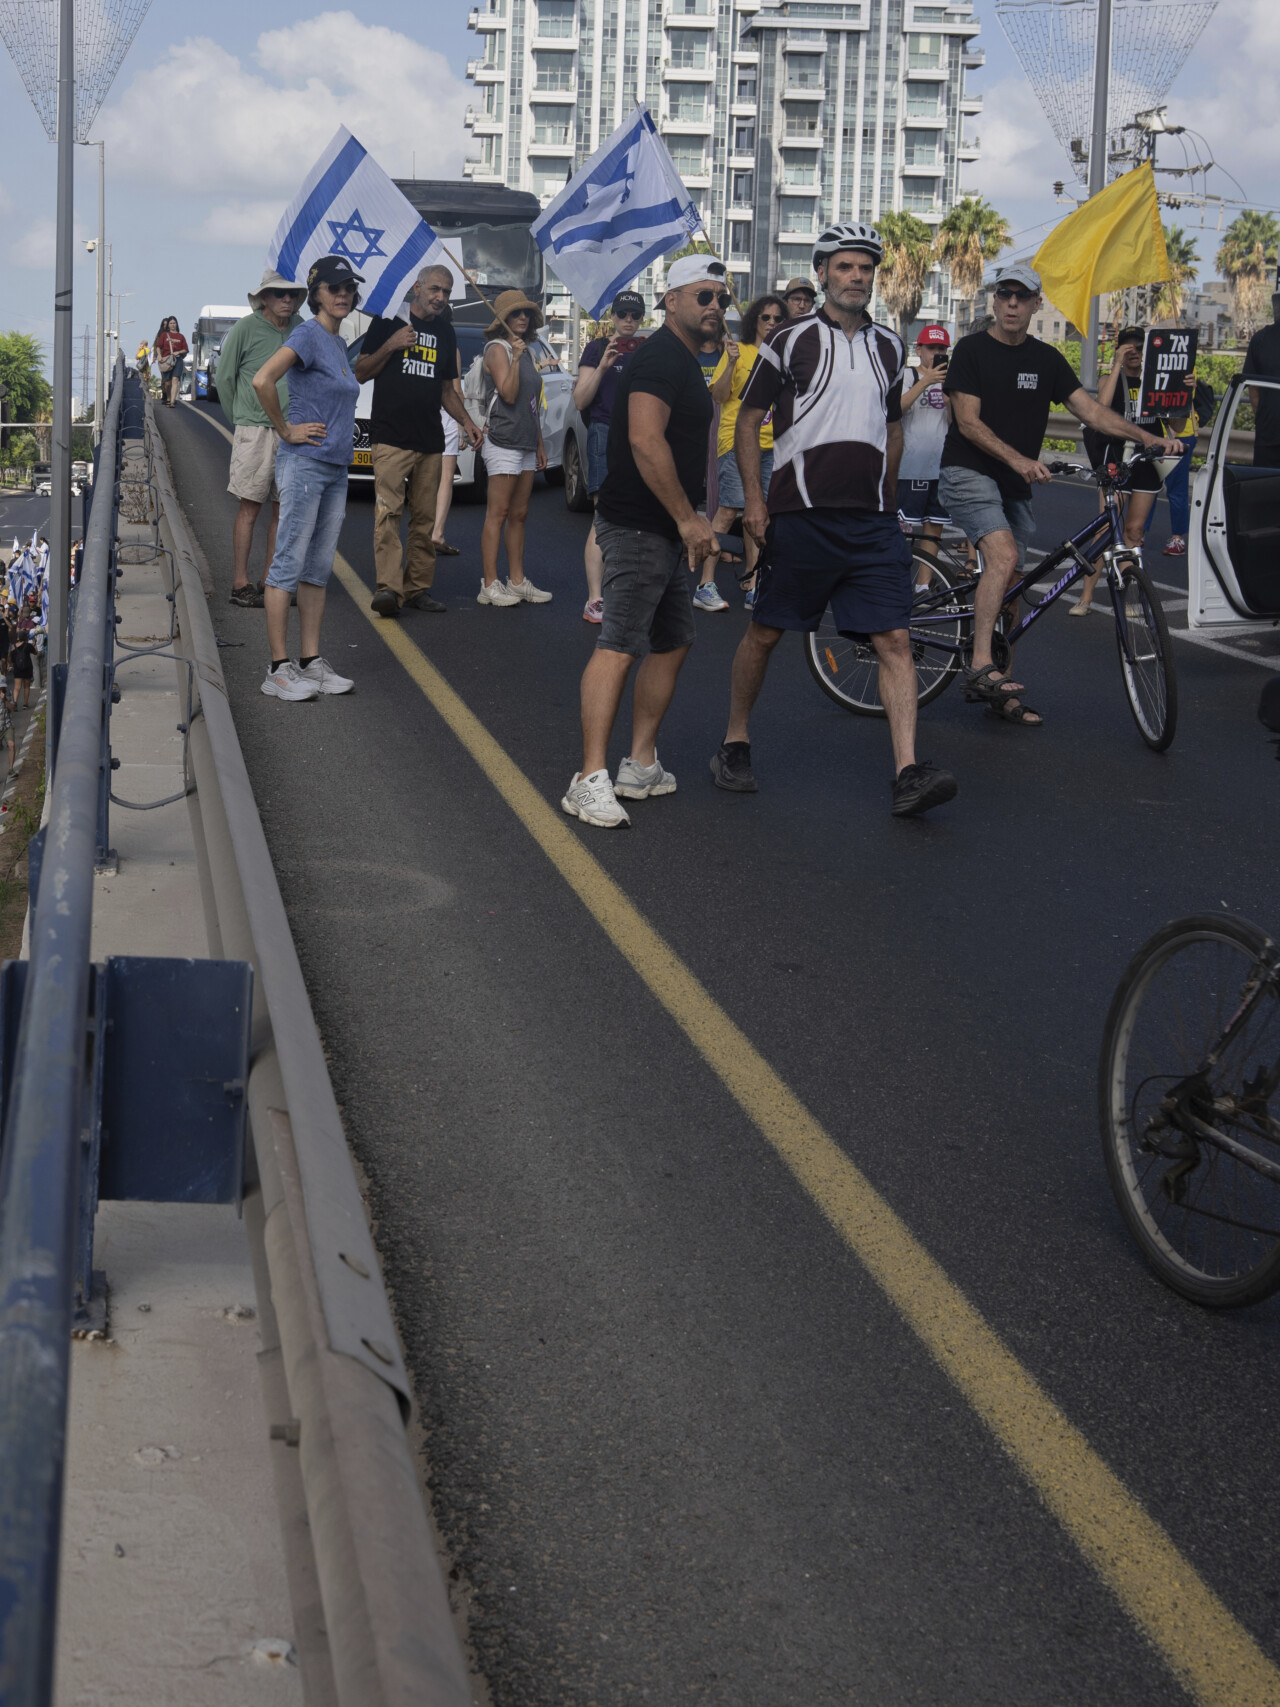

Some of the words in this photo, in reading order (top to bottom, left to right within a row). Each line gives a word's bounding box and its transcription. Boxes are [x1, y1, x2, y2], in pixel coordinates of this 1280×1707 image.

[1169, 334, 1190, 353] אל
[1157, 353, 1190, 371] תתנו
[1154, 372, 1170, 391] לו
[1147, 391, 1190, 408] להקריב
